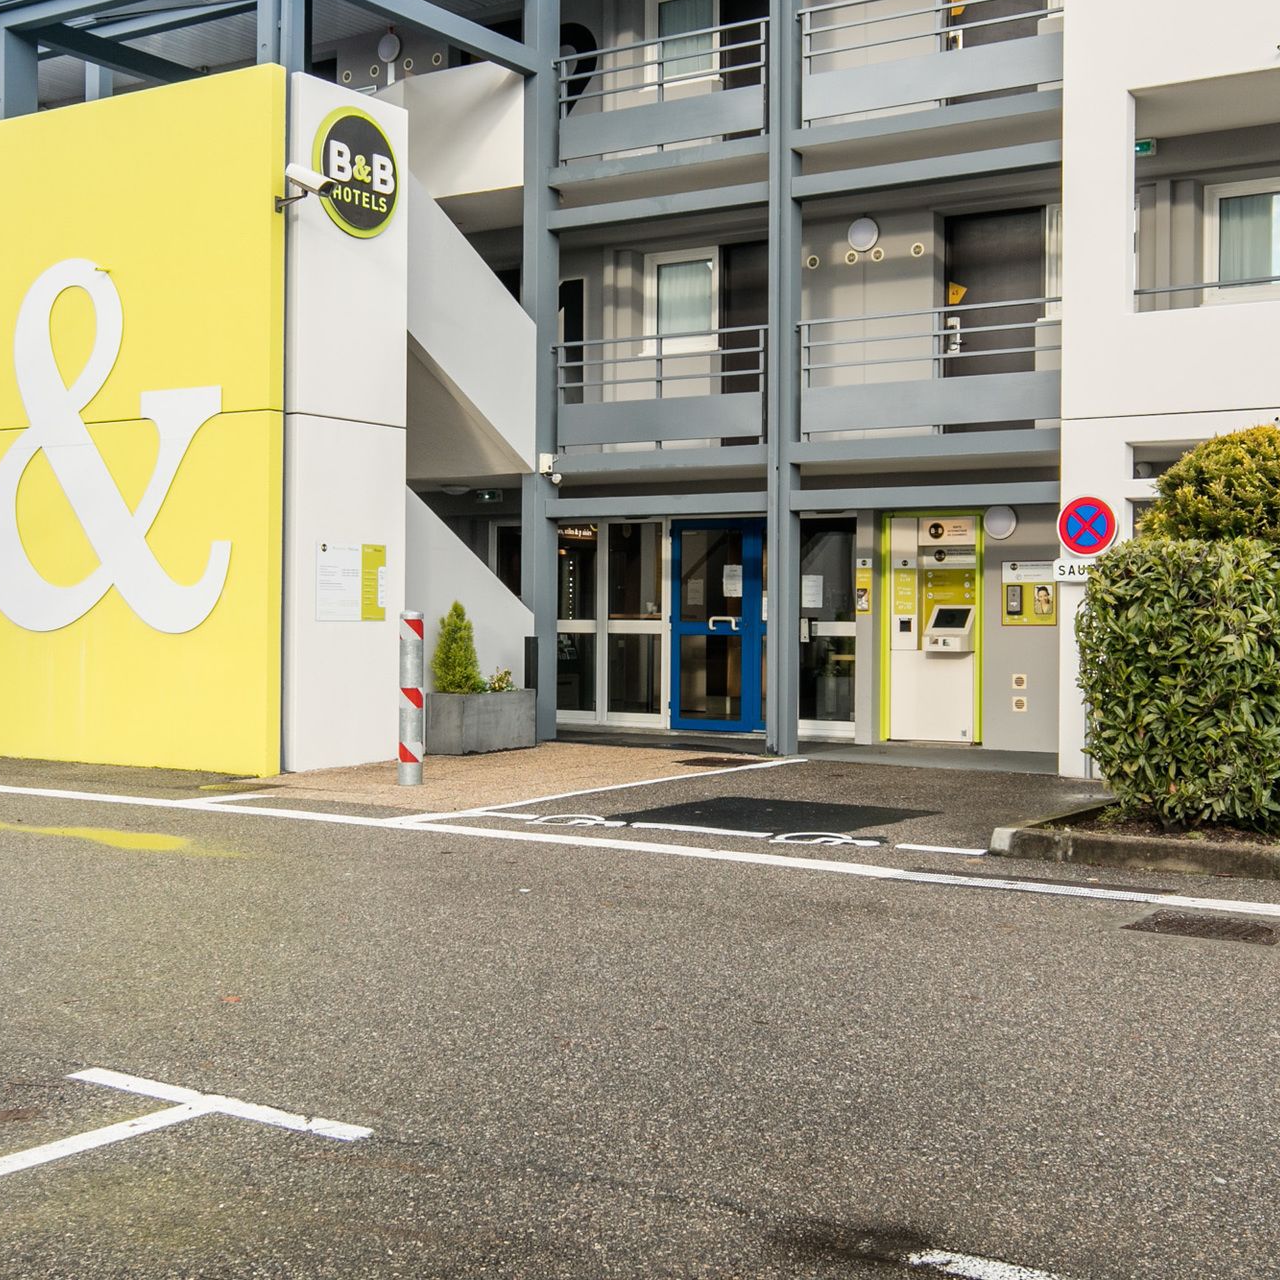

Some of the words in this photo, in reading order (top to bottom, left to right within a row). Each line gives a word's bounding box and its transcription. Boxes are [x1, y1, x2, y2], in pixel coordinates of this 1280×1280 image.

[329, 140, 395, 195] B&B
[333, 185, 387, 213] HOTELS
[1058, 564, 1096, 576] SAU
